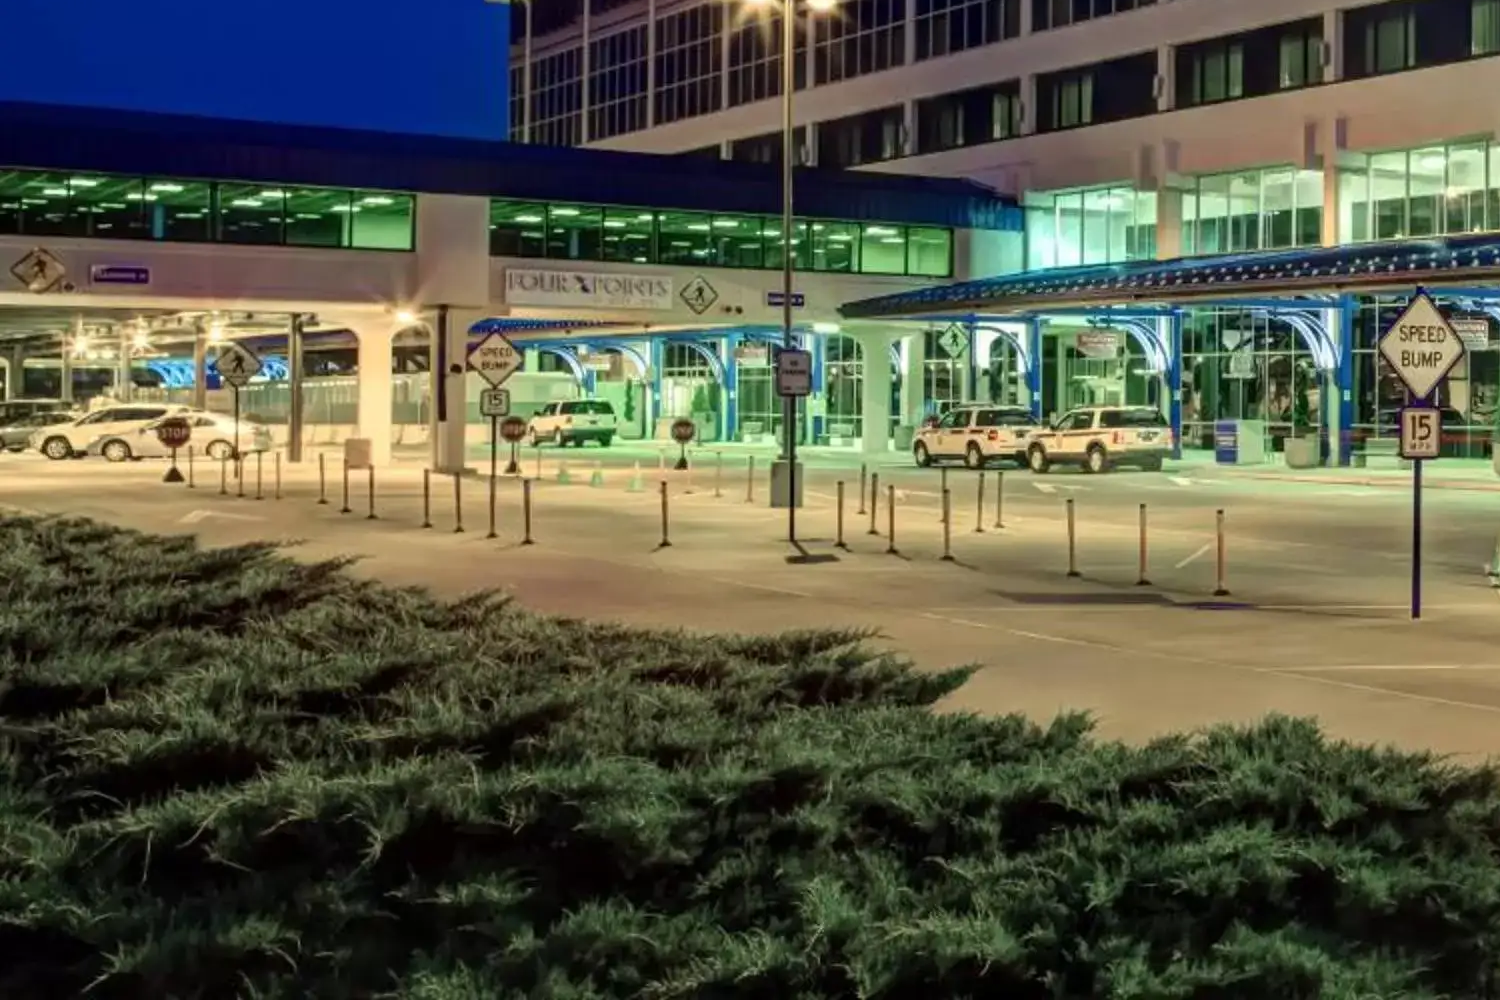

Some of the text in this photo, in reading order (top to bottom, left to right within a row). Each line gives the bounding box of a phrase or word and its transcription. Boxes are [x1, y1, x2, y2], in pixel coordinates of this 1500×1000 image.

[508, 271, 668, 298] FOUR POINTS
[1399, 324, 1447, 343] SPEED
[1400, 350, 1443, 368] BUMP
[487, 393, 503, 407] 15
[1409, 414, 1431, 441] 15
